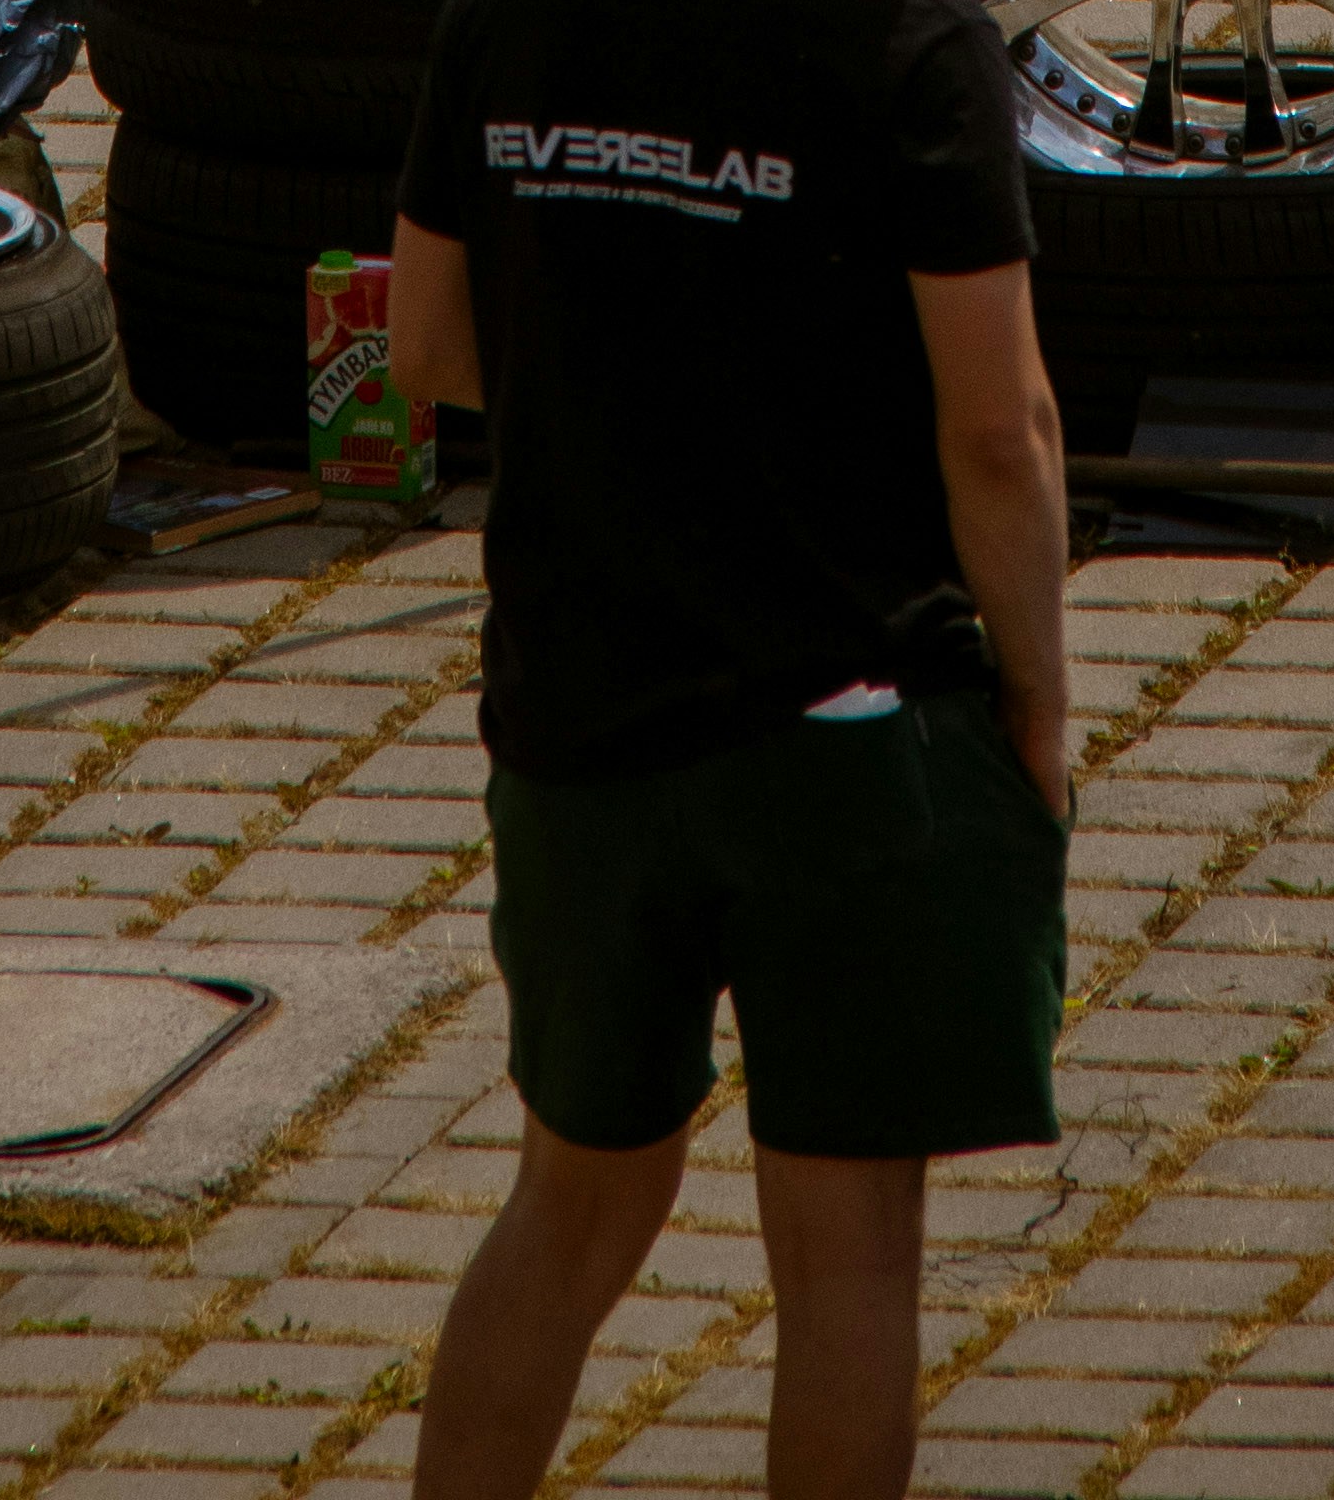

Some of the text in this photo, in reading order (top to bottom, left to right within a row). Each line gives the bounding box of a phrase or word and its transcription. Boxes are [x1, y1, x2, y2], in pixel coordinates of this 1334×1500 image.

[484, 123, 794, 201] REVERSELAB
[307, 338, 388, 415] TYMBAR
[320, 466, 352, 484] BEZ
